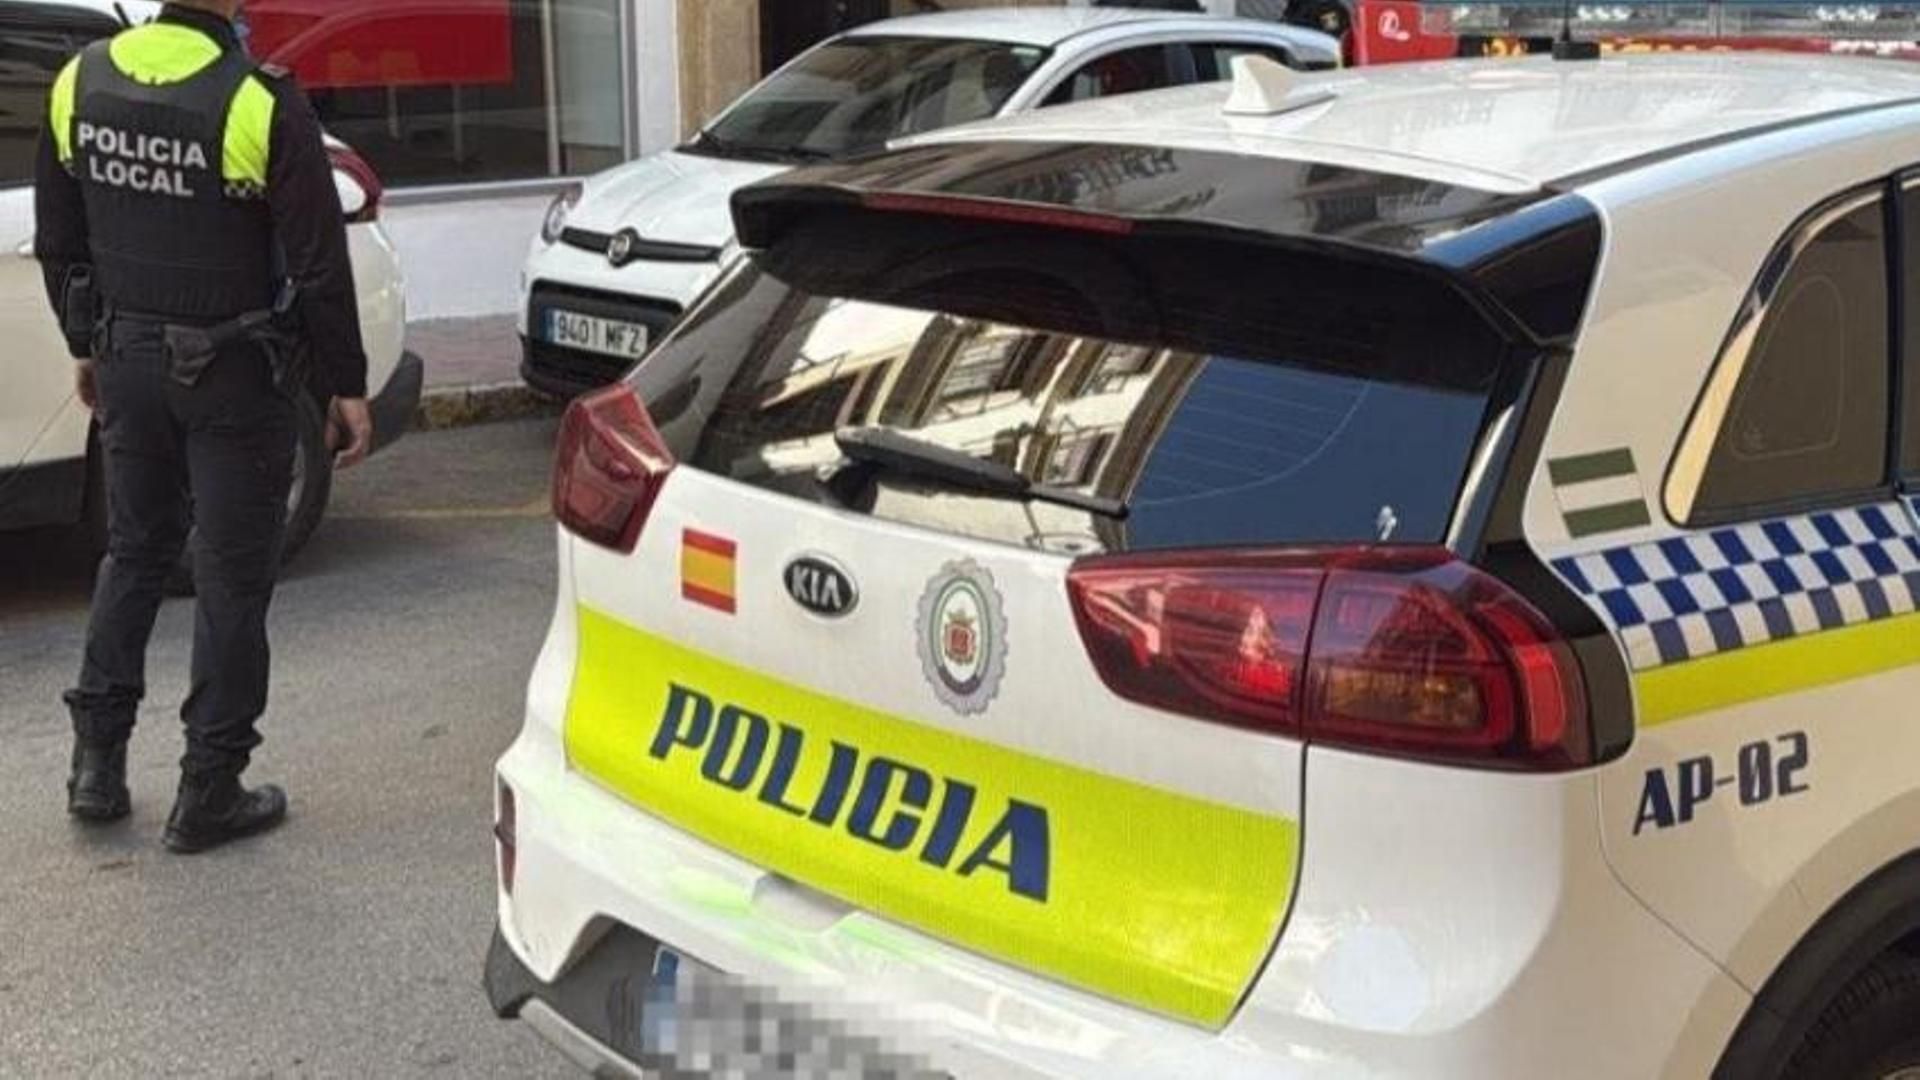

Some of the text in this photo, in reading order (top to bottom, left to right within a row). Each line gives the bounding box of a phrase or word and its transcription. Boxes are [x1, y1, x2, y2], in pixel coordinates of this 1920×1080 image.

[78, 122, 207, 169] POLICIA
[88, 157, 194, 197] LOCAL
[557, 313, 600, 347] 9401
[792, 565, 842, 608] KIA
[649, 682, 1051, 903] POLICIA
[1632, 731, 1810, 836] AP-02
